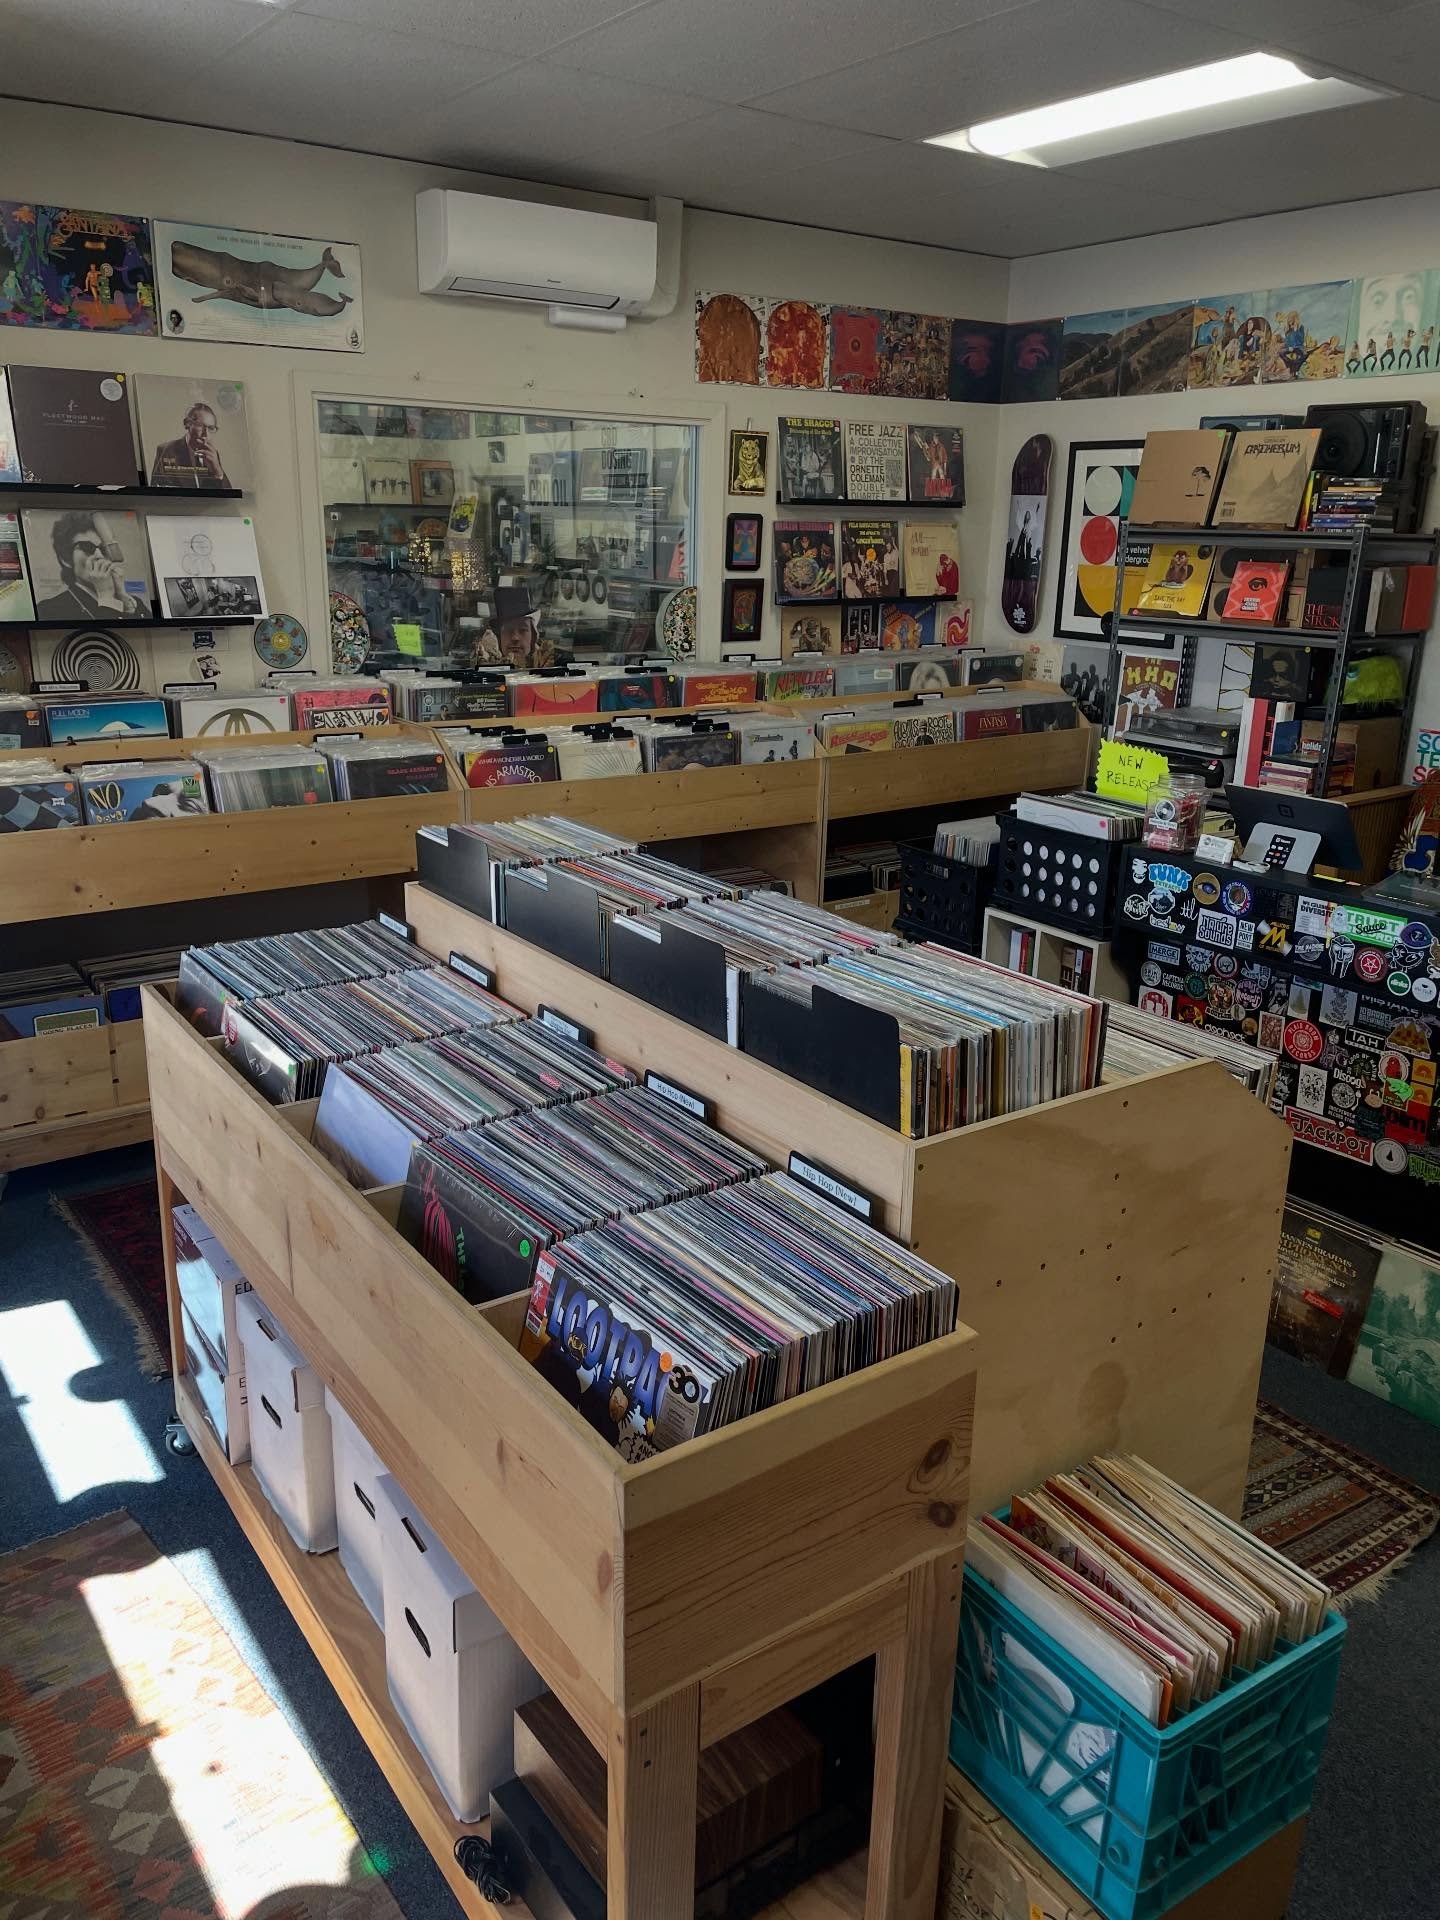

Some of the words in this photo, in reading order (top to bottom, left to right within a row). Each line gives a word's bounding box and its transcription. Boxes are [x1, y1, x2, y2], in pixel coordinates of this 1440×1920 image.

[786, 418, 802, 427] THE
[804, 419, 834, 428] SHAGGS
[849, 423, 875, 437] FREE
[859, 438, 904, 448] COLLECTIVE
[849, 447, 904, 457] IMPROVISATION
[859, 457, 868, 465] BY
[871, 457, 884, 466] THE
[850, 465, 885, 475] ORNETTE
[850, 474, 885, 483] COLEMAN
[850, 483, 885, 492] DOUBLE
[1130, 545, 1150, 555] velvet
[1306, 603, 1329, 616] THE
[51, 710, 68, 719] FULL
[68, 708, 90, 717] MOON
[1118, 754, 1144, 770] NEW
[88, 781, 121, 811] NO
[1240, 921, 1254, 931] NEW
[1355, 921, 1387, 935] Sauce
[1151, 946, 1178, 958] MERGE
[1288, 1044, 1319, 1062] RECORDS
[1290, 1110, 1370, 1155] JACKPOT
[802, 1166, 816, 1182] Hip
[818, 1175, 834, 1192] Hop
[1312, 1246, 1353, 1268] BRAHMS
[669, 1363, 701, 1404] 30
